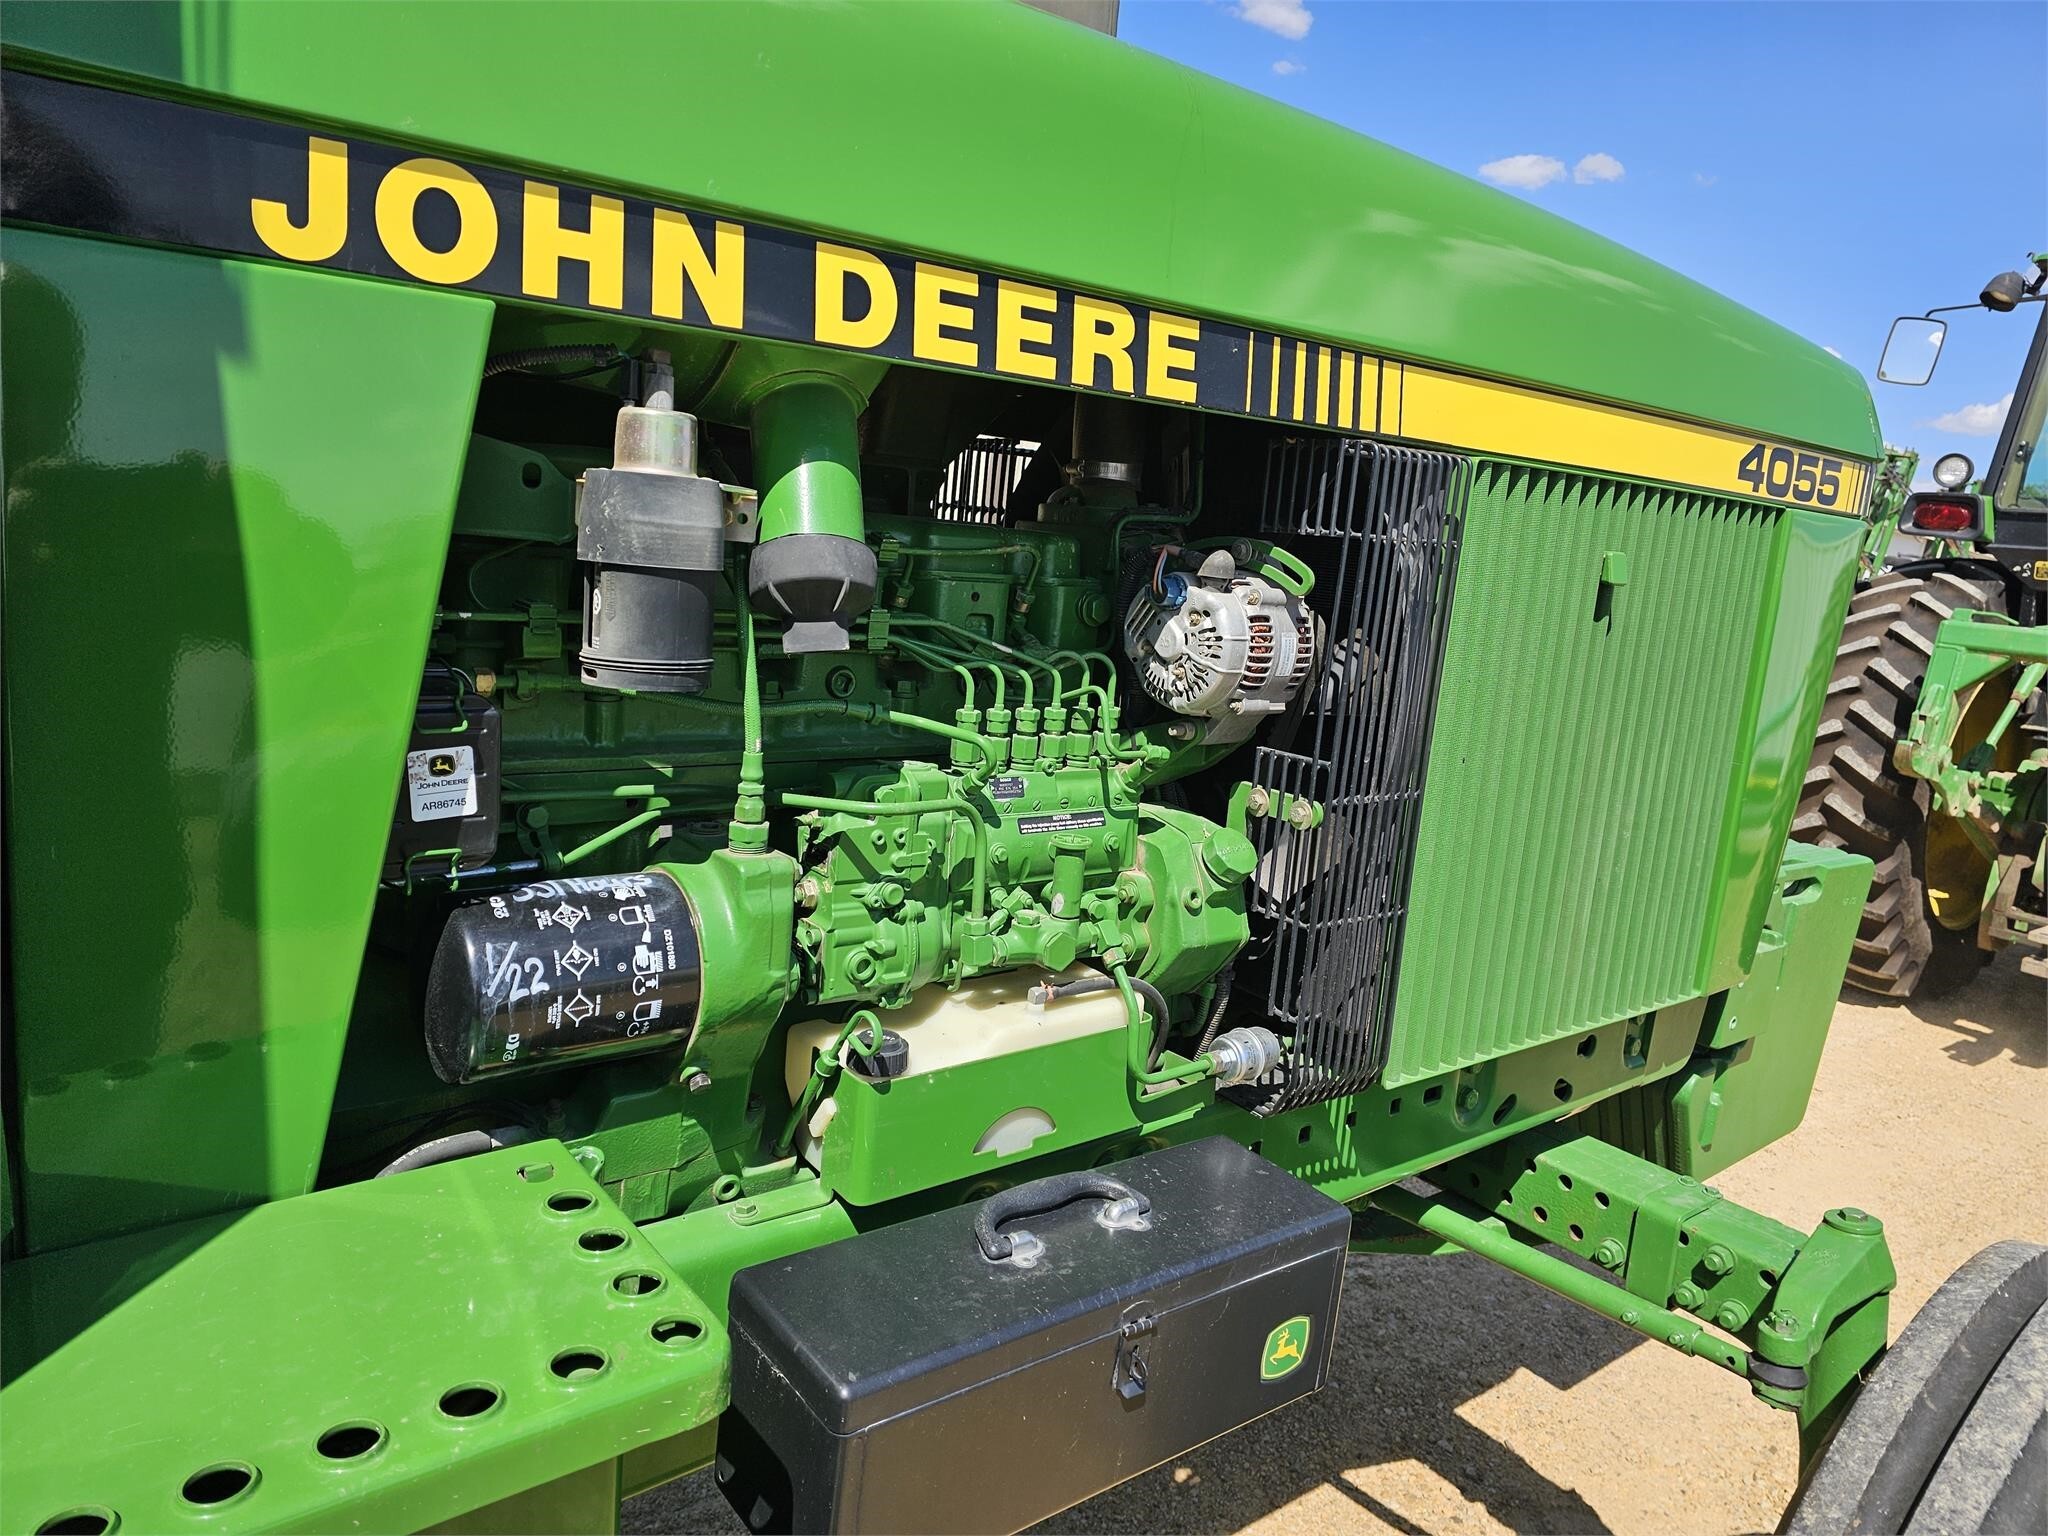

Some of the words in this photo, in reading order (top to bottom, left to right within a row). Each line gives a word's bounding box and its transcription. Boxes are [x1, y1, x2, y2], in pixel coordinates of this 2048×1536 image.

[250, 135, 747, 331] JOHN
[814, 241, 1201, 405] DEERE
[1737, 443, 1844, 507] 4055
[417, 781, 440, 790] JOHN
[441, 777, 469, 787] DEERE
[421, 797, 467, 811] AR86745
[486, 941, 550, 1001] 1/22
[664, 929, 676, 970] DZ101880
